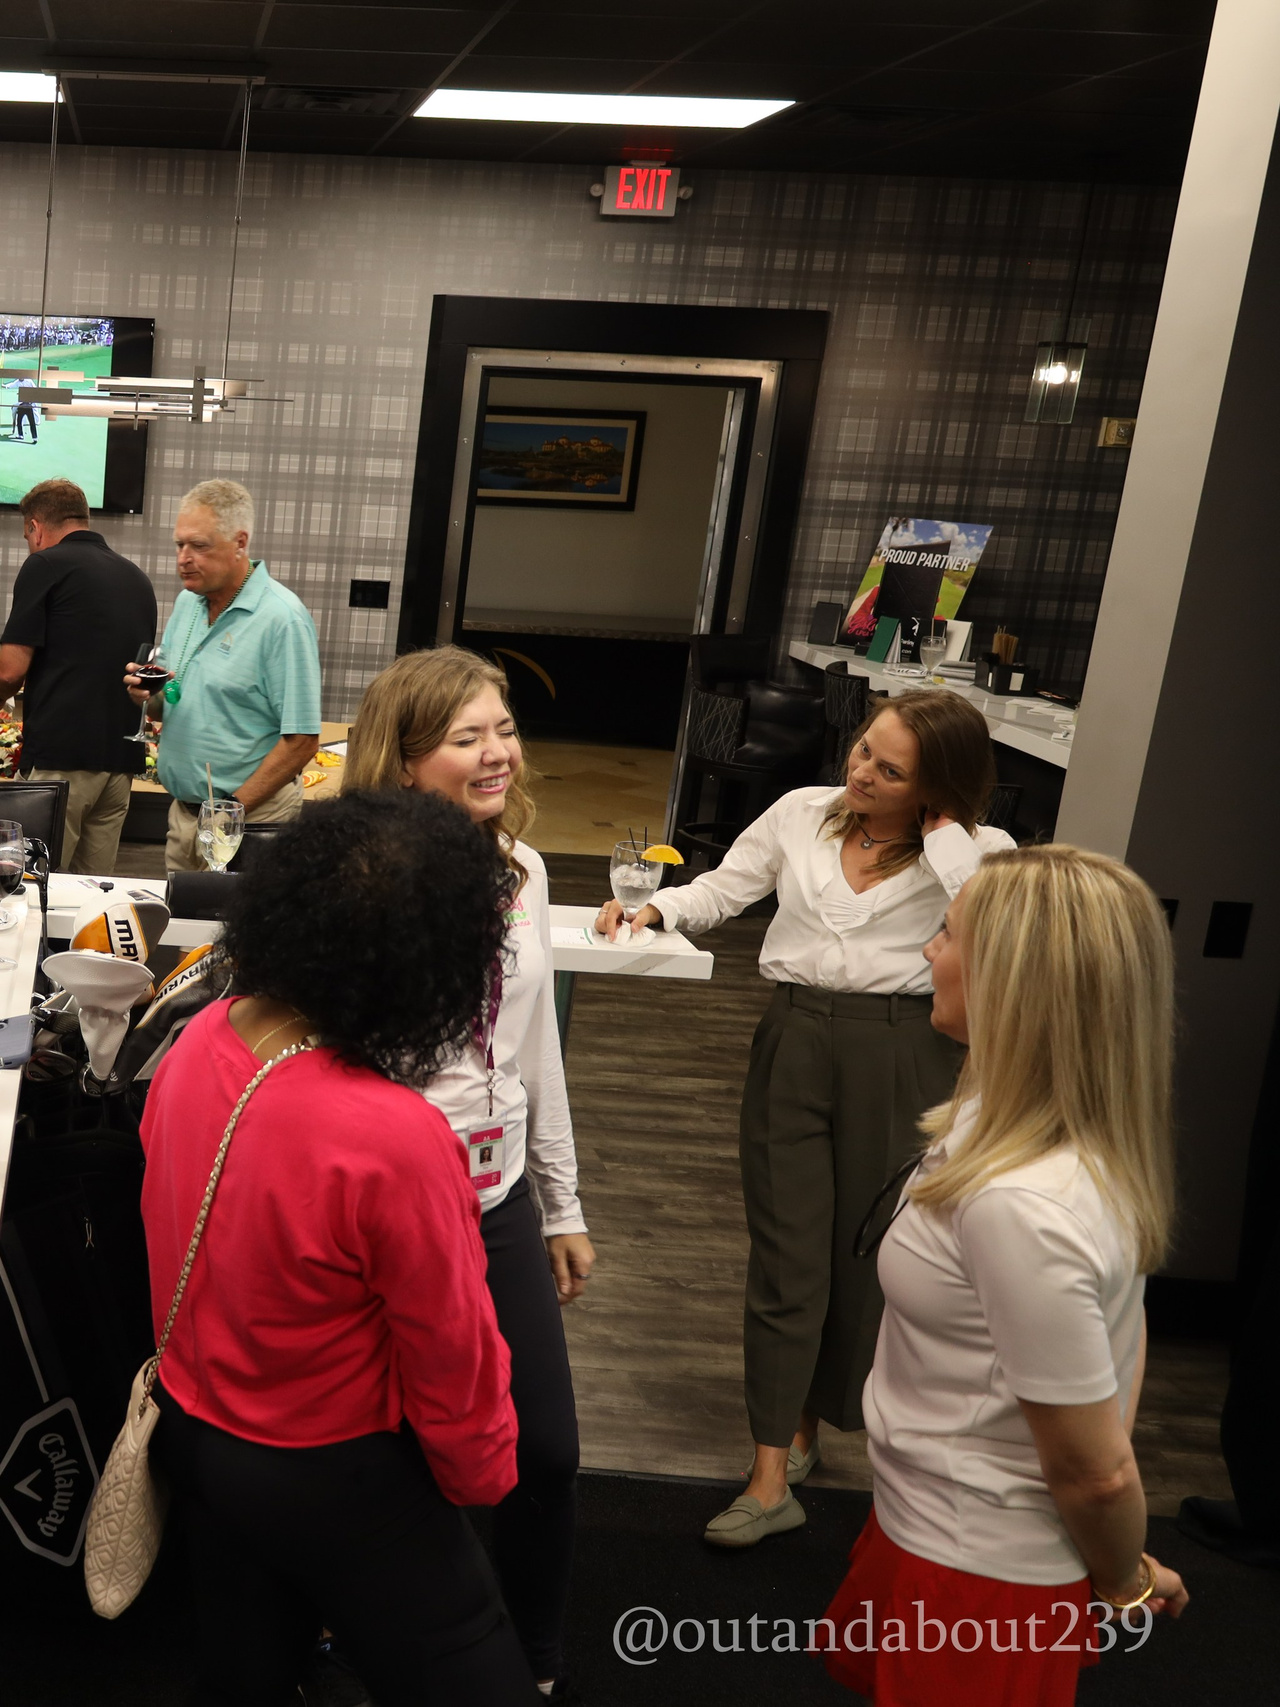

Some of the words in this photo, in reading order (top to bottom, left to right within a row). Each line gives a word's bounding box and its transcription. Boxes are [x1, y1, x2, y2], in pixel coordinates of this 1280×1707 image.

[615, 168, 672, 210] EXIT
[878, 548, 918, 566] PROUD
[916, 552, 971, 572] PARTNER
[37, 1432, 80, 1538] Callaway
